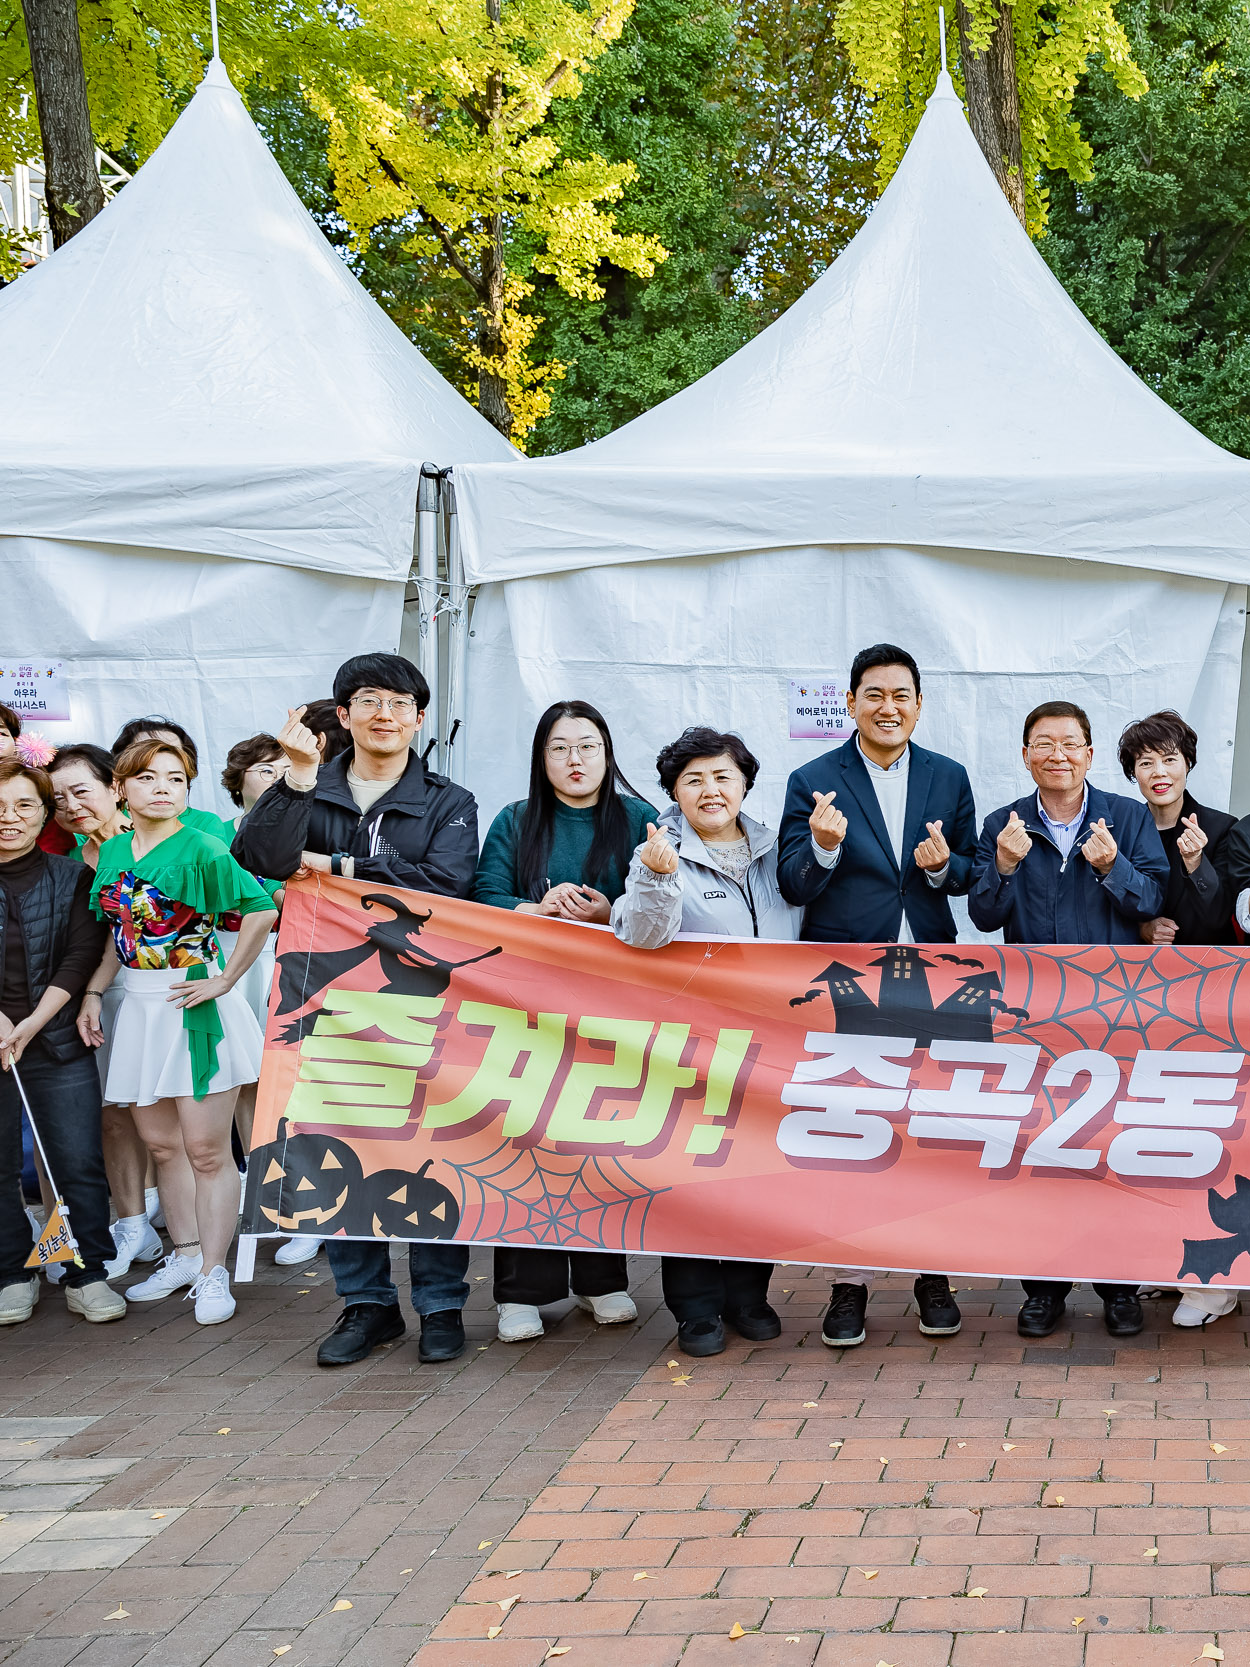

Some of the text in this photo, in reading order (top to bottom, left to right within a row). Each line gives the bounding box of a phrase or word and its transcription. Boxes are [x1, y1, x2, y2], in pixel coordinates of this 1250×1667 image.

[13, 688, 38, 698] 아우라
[796, 707, 850, 717] 에어로빅 마녀
[284, 988, 755, 1157] 즐겨라!
[775, 1030, 1247, 1180] 중곡2동
[37, 1224, 69, 1264] 중곡1동
